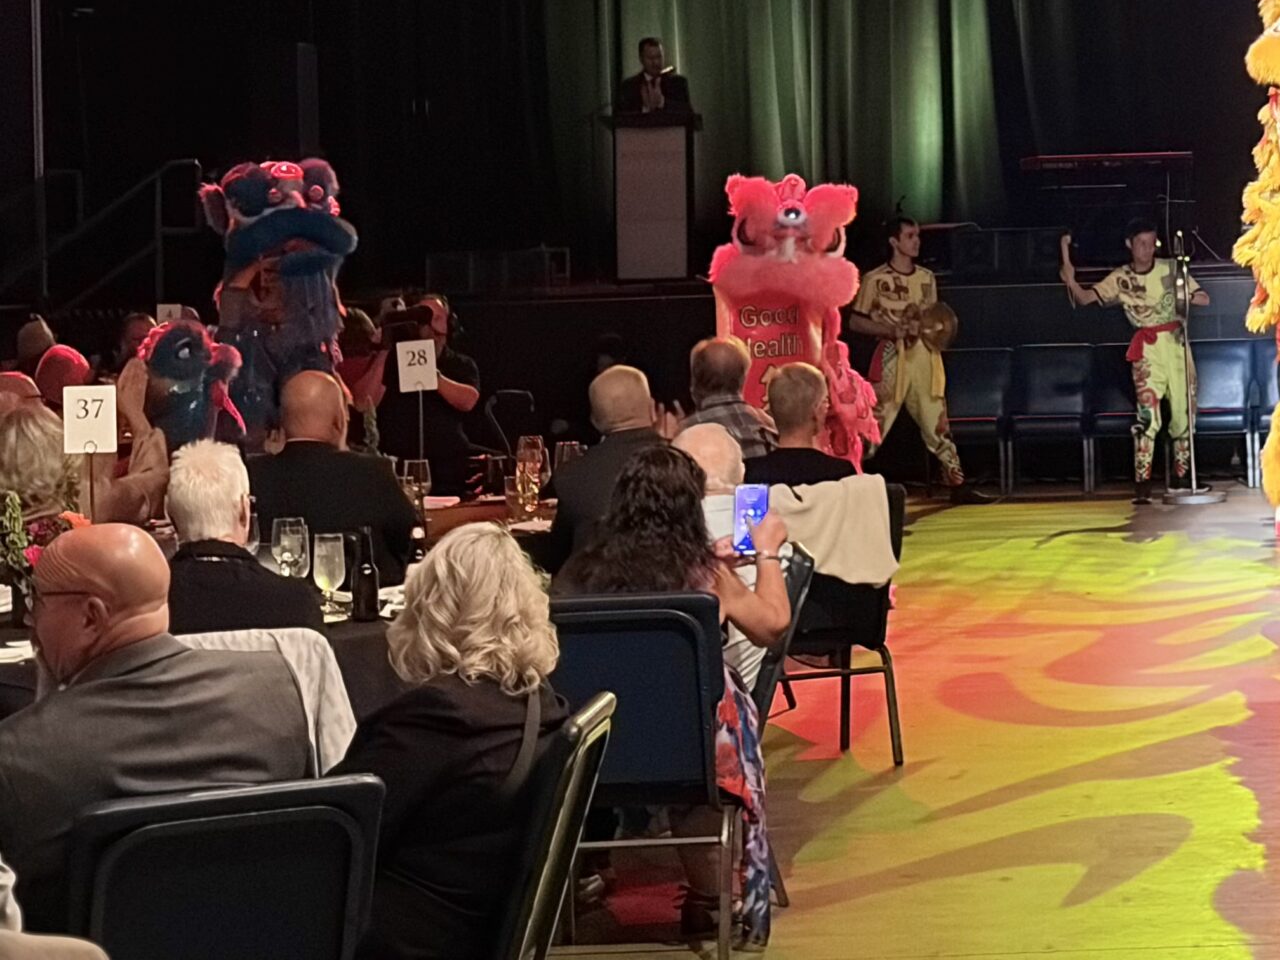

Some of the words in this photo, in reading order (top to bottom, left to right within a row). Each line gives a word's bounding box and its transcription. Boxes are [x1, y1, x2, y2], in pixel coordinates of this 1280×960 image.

[740, 304, 799, 328] Good
[406, 349, 428, 367] 28
[76, 398, 104, 419] 37
